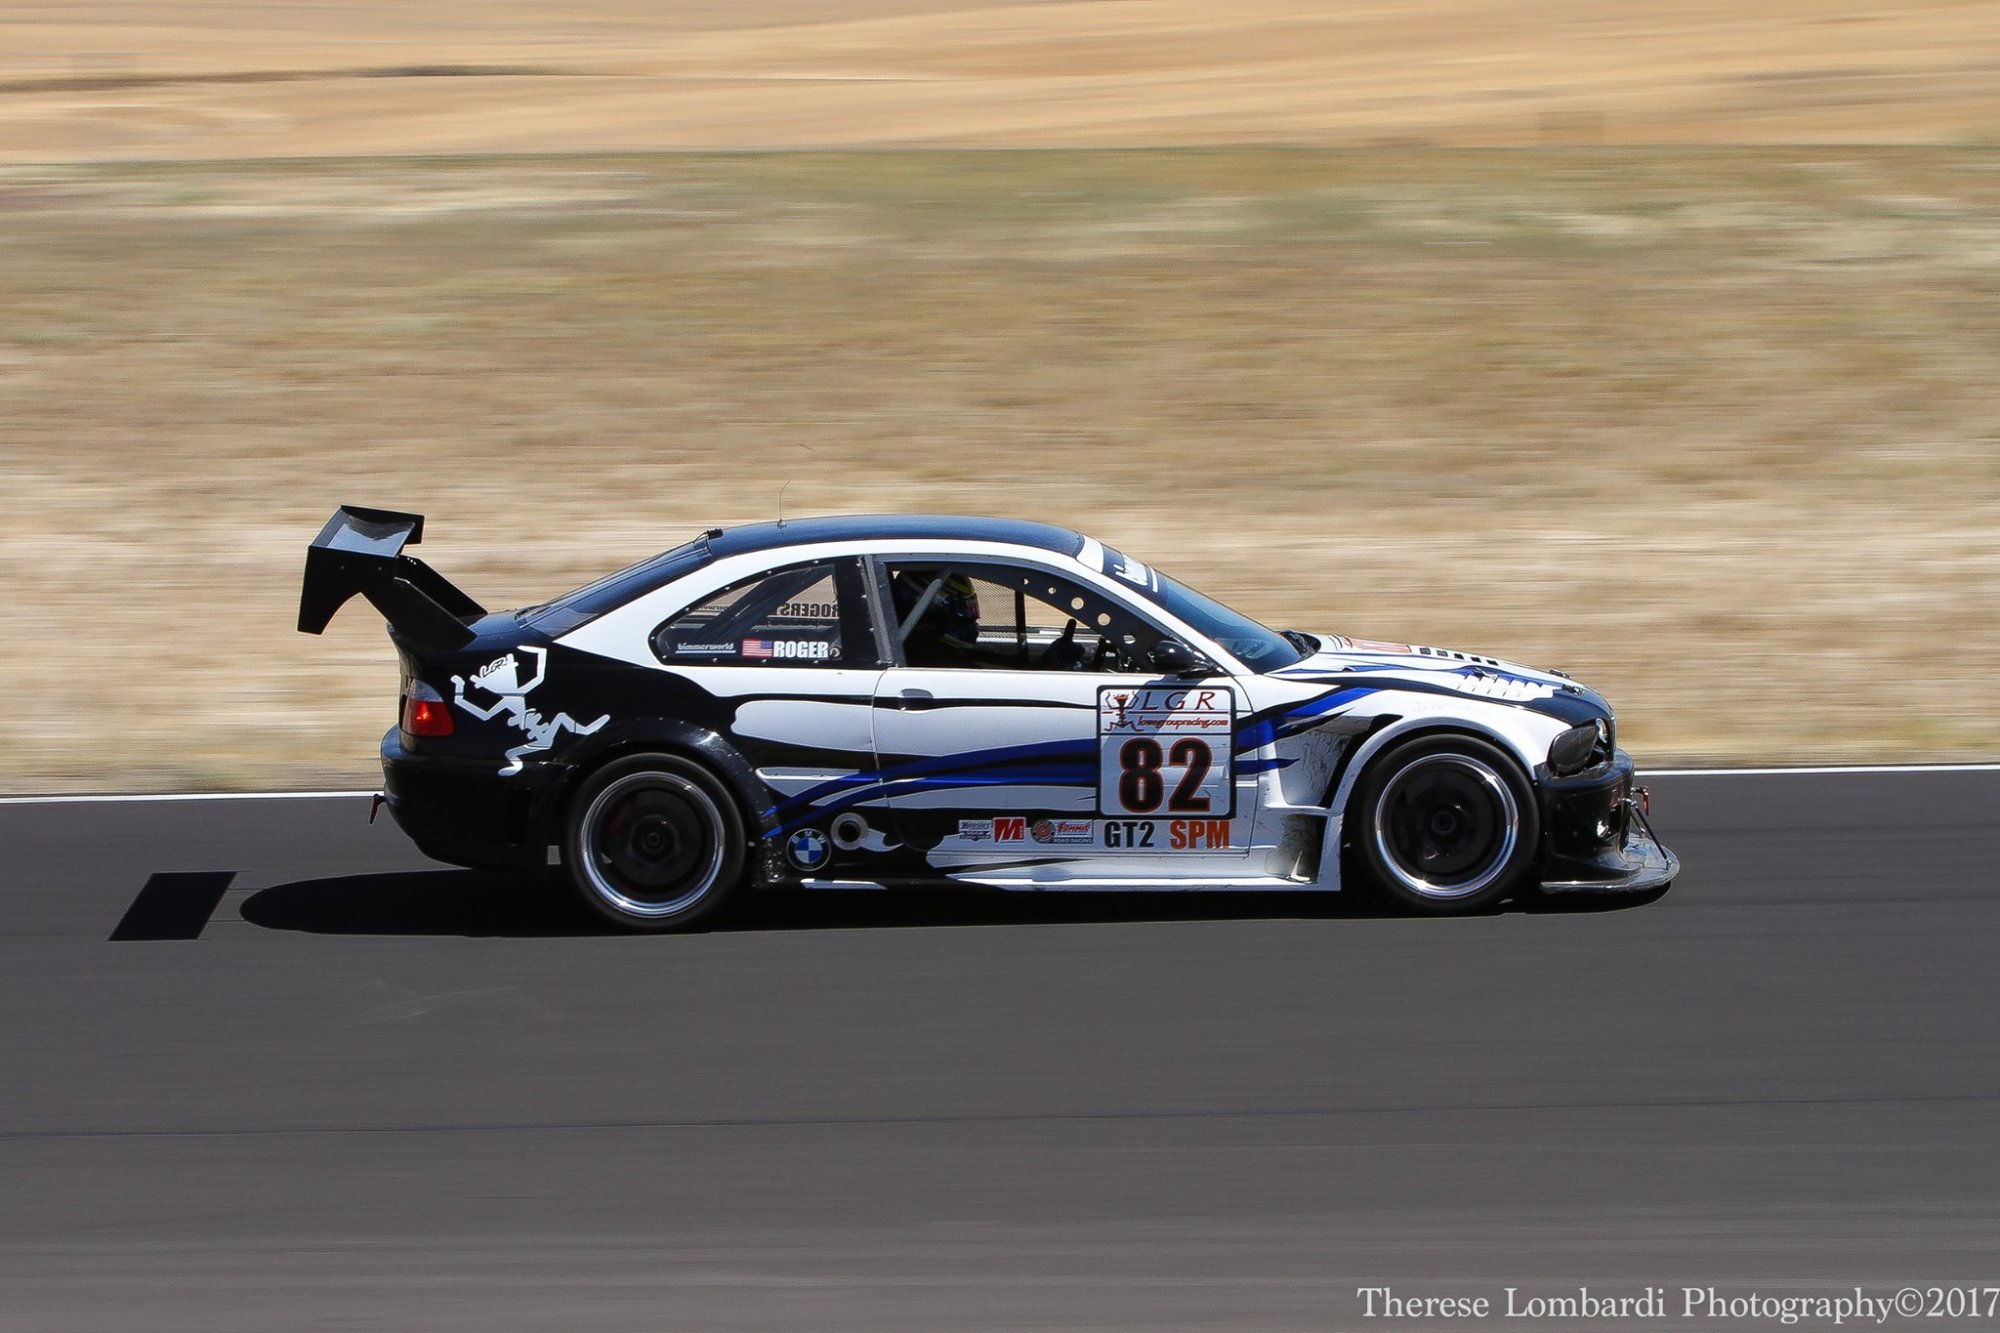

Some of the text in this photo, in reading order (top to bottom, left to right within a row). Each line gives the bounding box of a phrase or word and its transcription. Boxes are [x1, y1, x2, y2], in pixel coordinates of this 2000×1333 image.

[1119, 737, 1213, 813] 82
[1104, 820, 1230, 850] GT2 SPM
